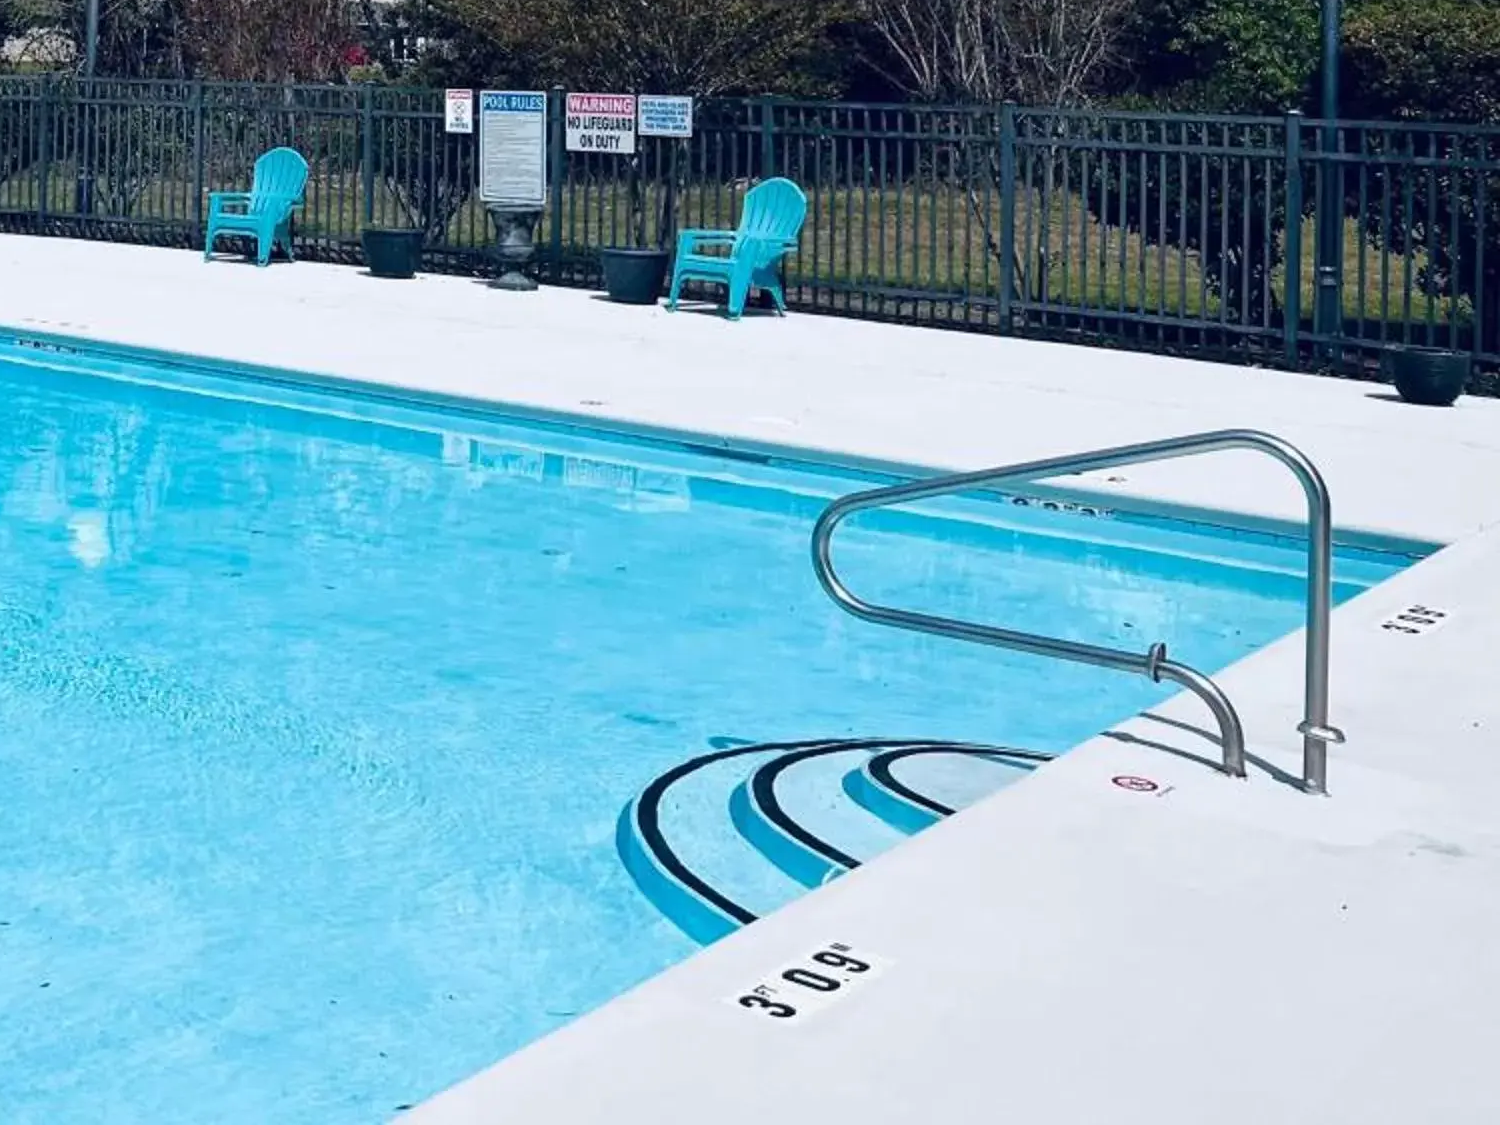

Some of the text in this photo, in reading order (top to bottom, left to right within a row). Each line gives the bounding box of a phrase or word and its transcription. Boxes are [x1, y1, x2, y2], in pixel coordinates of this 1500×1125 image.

[483, 95, 508, 109] POOL
[510, 96, 543, 110] RULES
[569, 96, 633, 115] WARNING
[567, 116, 633, 132] NO LIFEGUARD
[579, 134, 621, 149] ON DUTY
